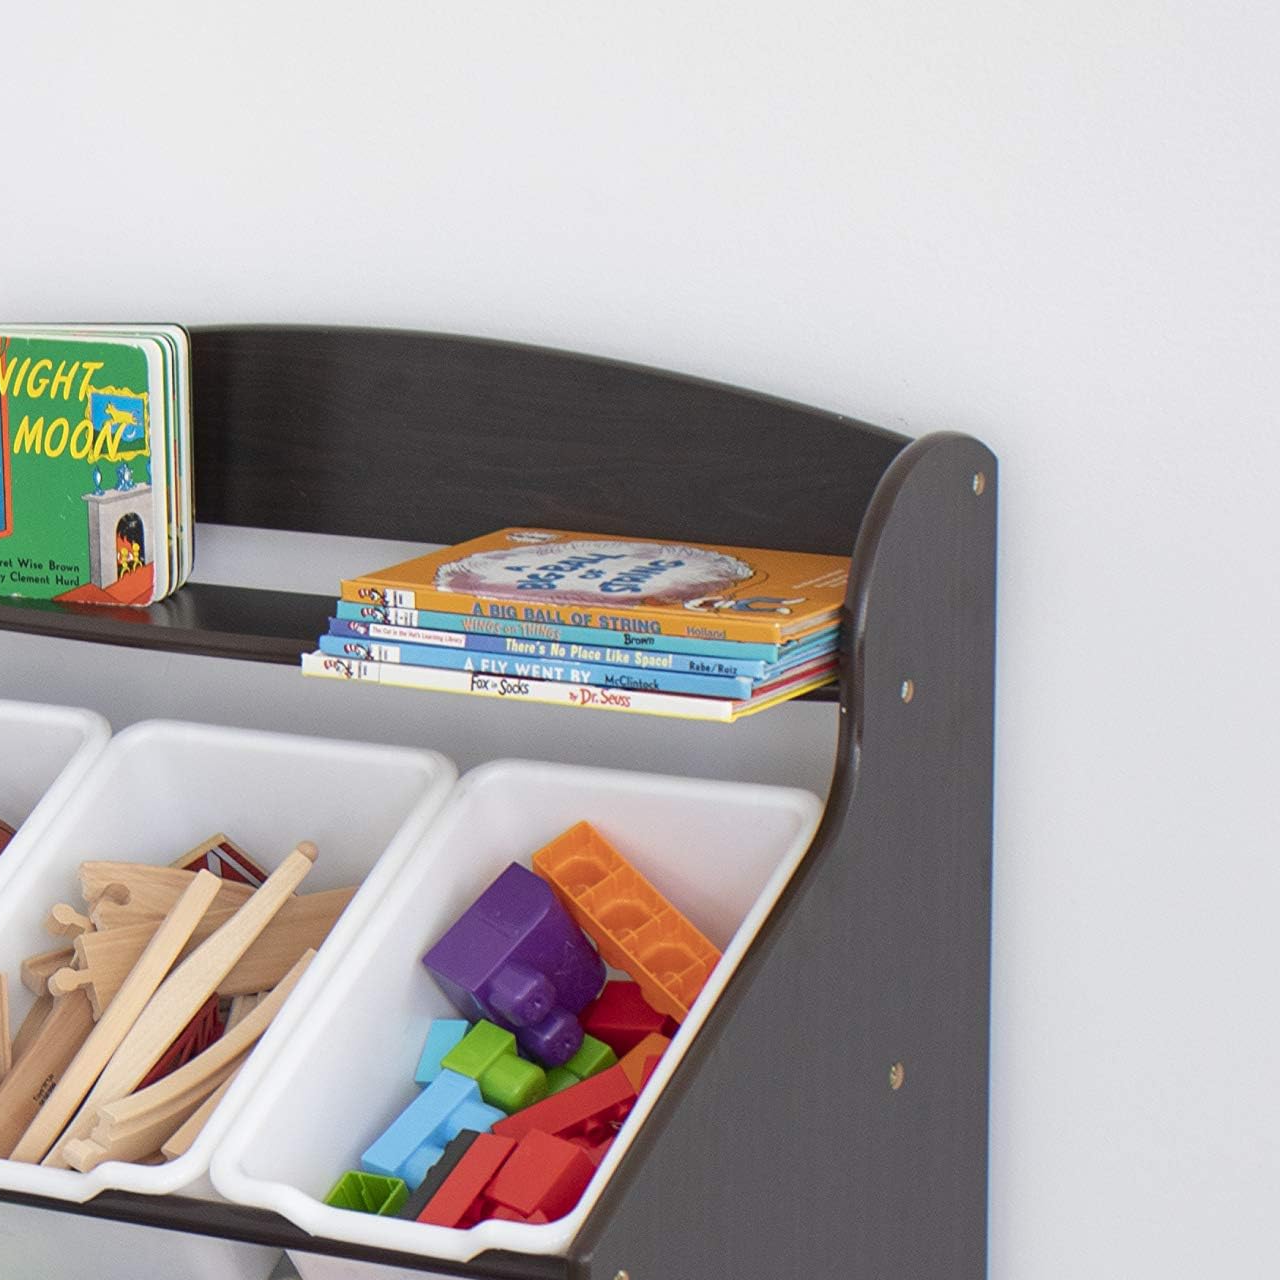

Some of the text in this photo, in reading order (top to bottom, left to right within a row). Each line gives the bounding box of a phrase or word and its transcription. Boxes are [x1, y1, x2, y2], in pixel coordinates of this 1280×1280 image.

[13, 416, 126, 459] MOON
[19, 558, 43, 570] Wise
[49, 559, 80, 573] Brown
[10, 571, 50, 585] Clement
[55, 575, 80, 586] Hurd
[472, 603, 662, 634] A BIG BALL OF STRING
[461, 618, 502, 635] WINGS
[521, 622, 562, 640] THINGS
[686, 626, 727, 639] Holland
[624, 633, 655, 646] Brown
[506, 637, 673, 668] There's No Place Like Space!
[464, 657, 592, 684] A FLY WENT BY
[471, 674, 489, 691] Fox
[499, 679, 529, 695] Socks
[605, 675, 659, 689] McClintock
[580, 688, 599, 705] Dr.
[601, 689, 631, 707] Seuss
